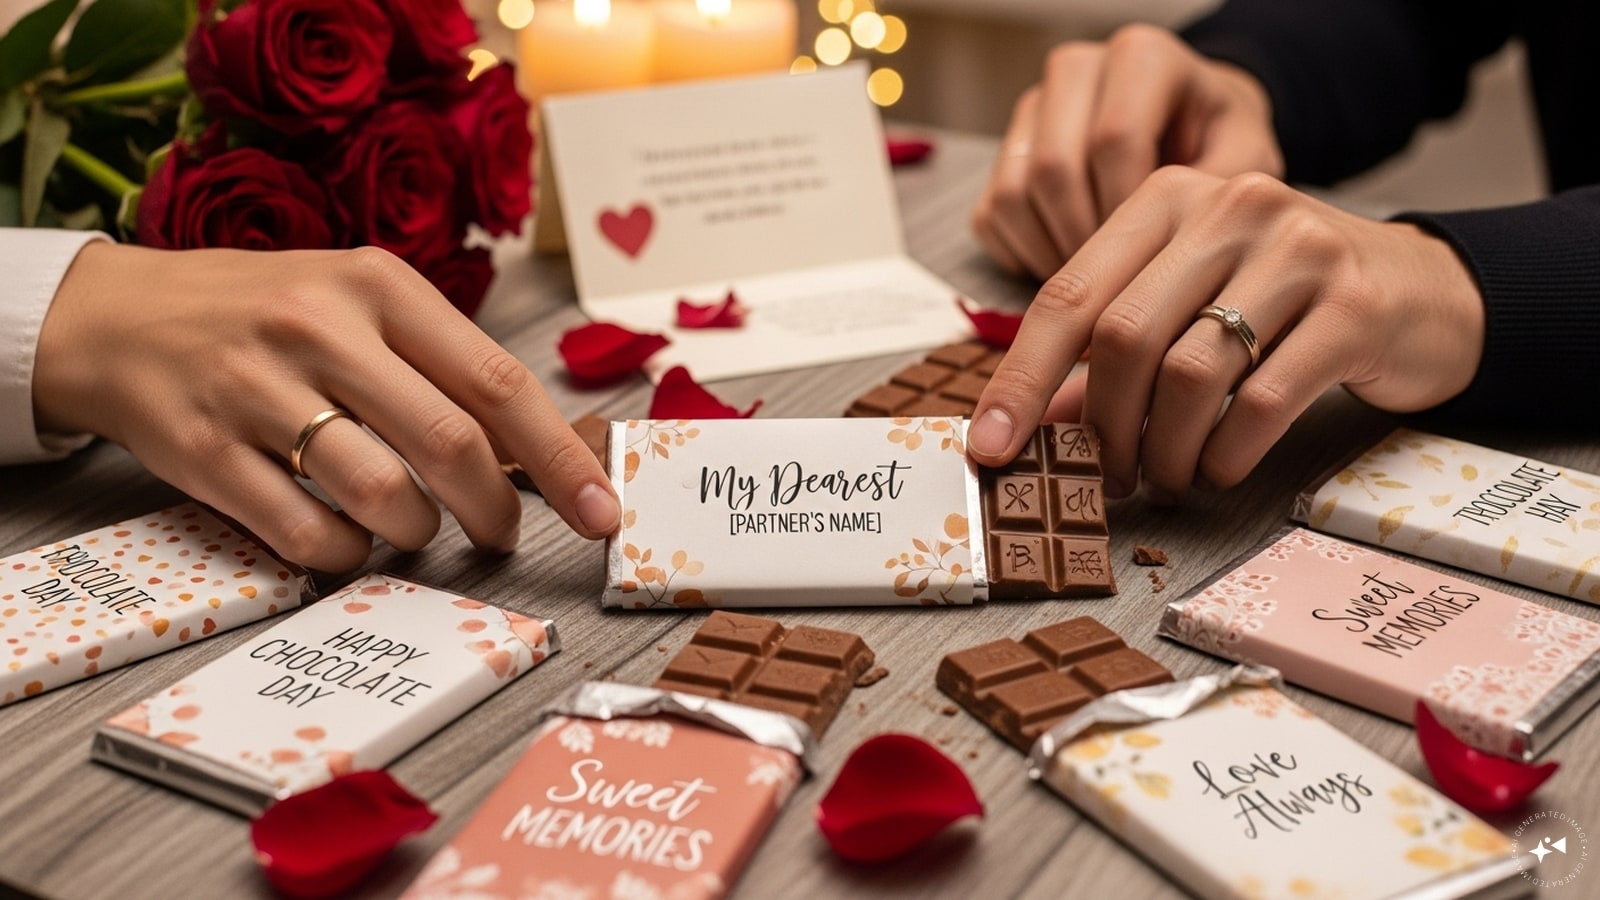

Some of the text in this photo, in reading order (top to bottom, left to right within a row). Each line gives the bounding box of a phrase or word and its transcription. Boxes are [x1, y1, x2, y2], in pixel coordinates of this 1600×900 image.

[700, 459, 912, 511] My Dearest
[730, 512, 882, 536] [PARTNER'S NAME]
[21, 578, 81, 608] DAY
[1311, 571, 1415, 632] Sweet
[322, 627, 430, 668] HAPPY
[1361, 585, 1481, 658] MEMORIES
[249, 639, 432, 706] CHOCOLATE
[257, 675, 335, 708] DAY
[545, 758, 718, 821] Sweet
[1192, 751, 1297, 800] Love
[1233, 772, 1373, 840] Always
[501, 803, 714, 872] MEMORIES
